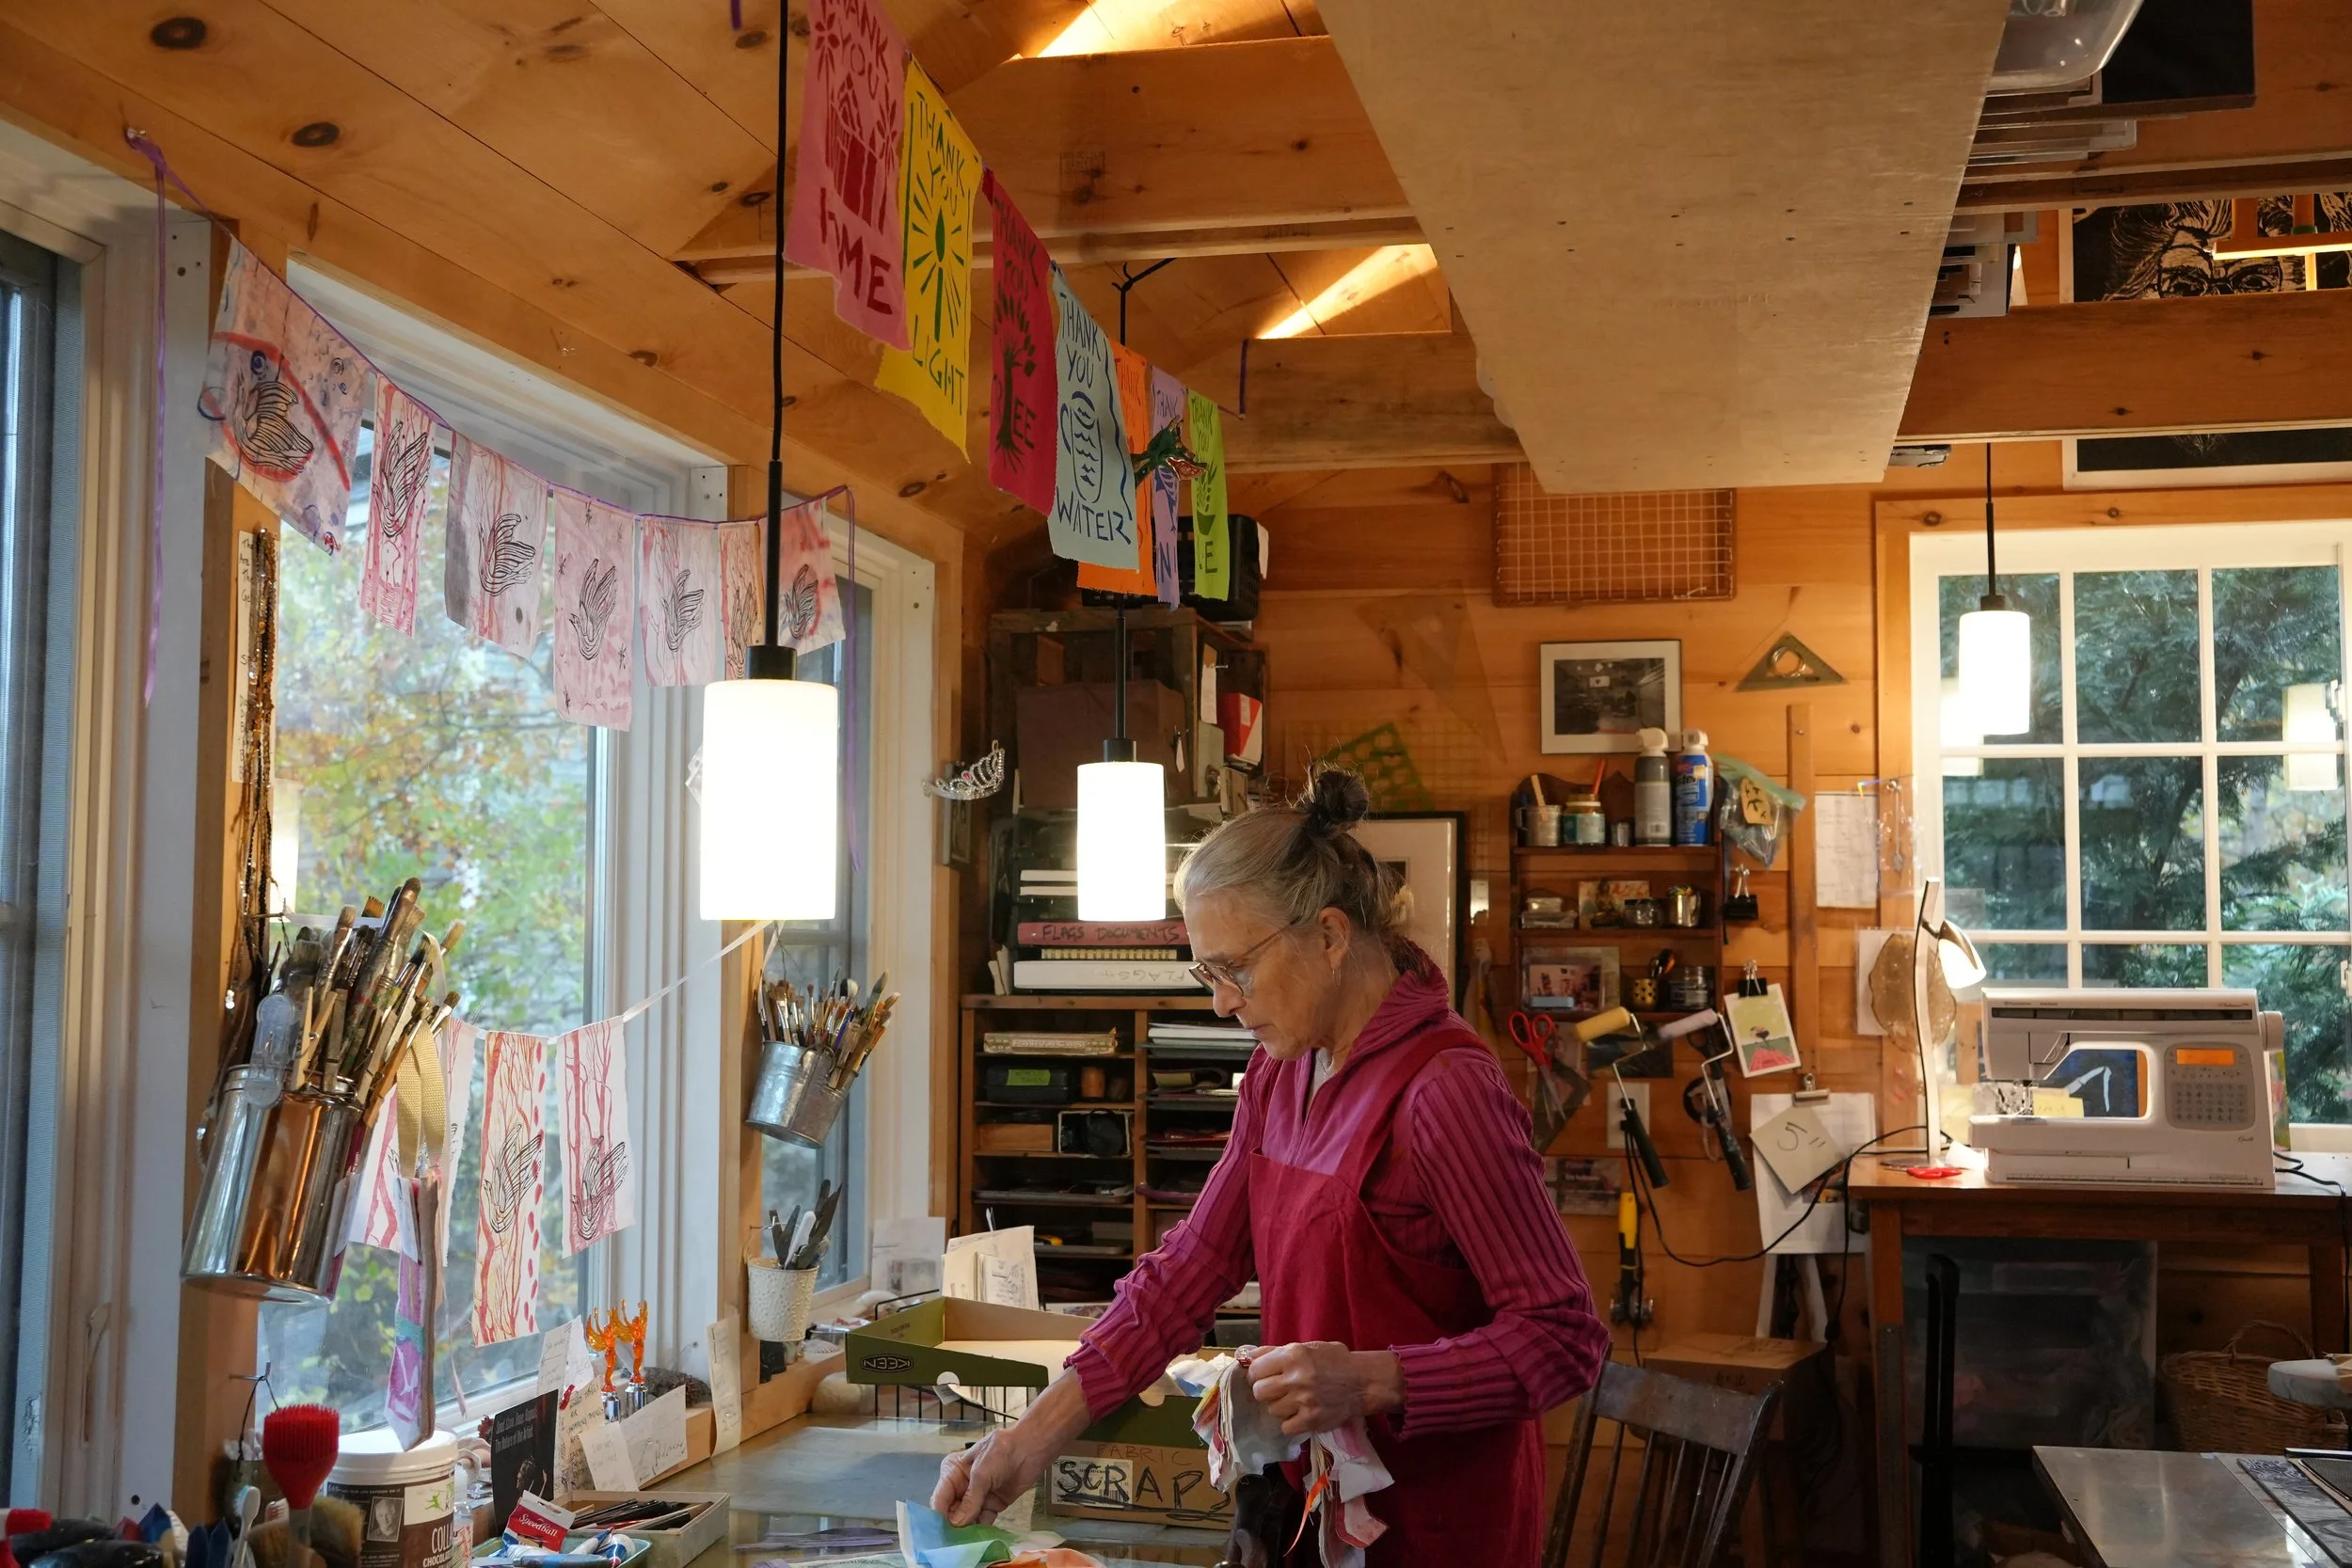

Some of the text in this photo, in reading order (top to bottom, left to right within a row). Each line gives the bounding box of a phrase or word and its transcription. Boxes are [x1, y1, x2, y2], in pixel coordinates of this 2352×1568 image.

[916, 90, 965, 198] THANK
[928, 150, 958, 216] YOU
[1059, 292, 1101, 361] THANK
[913, 314, 965, 416] LIGHT
[1066, 343, 1094, 388] YOU
[1056, 486, 1132, 545] WATER
[1041, 924, 1180, 944] FLAGS DOCUMENTS
[863, 1356, 911, 1370] KEEN
[1096, 1443, 1194, 1466] FABRIC
[518, 1513, 558, 1538] Speedball
